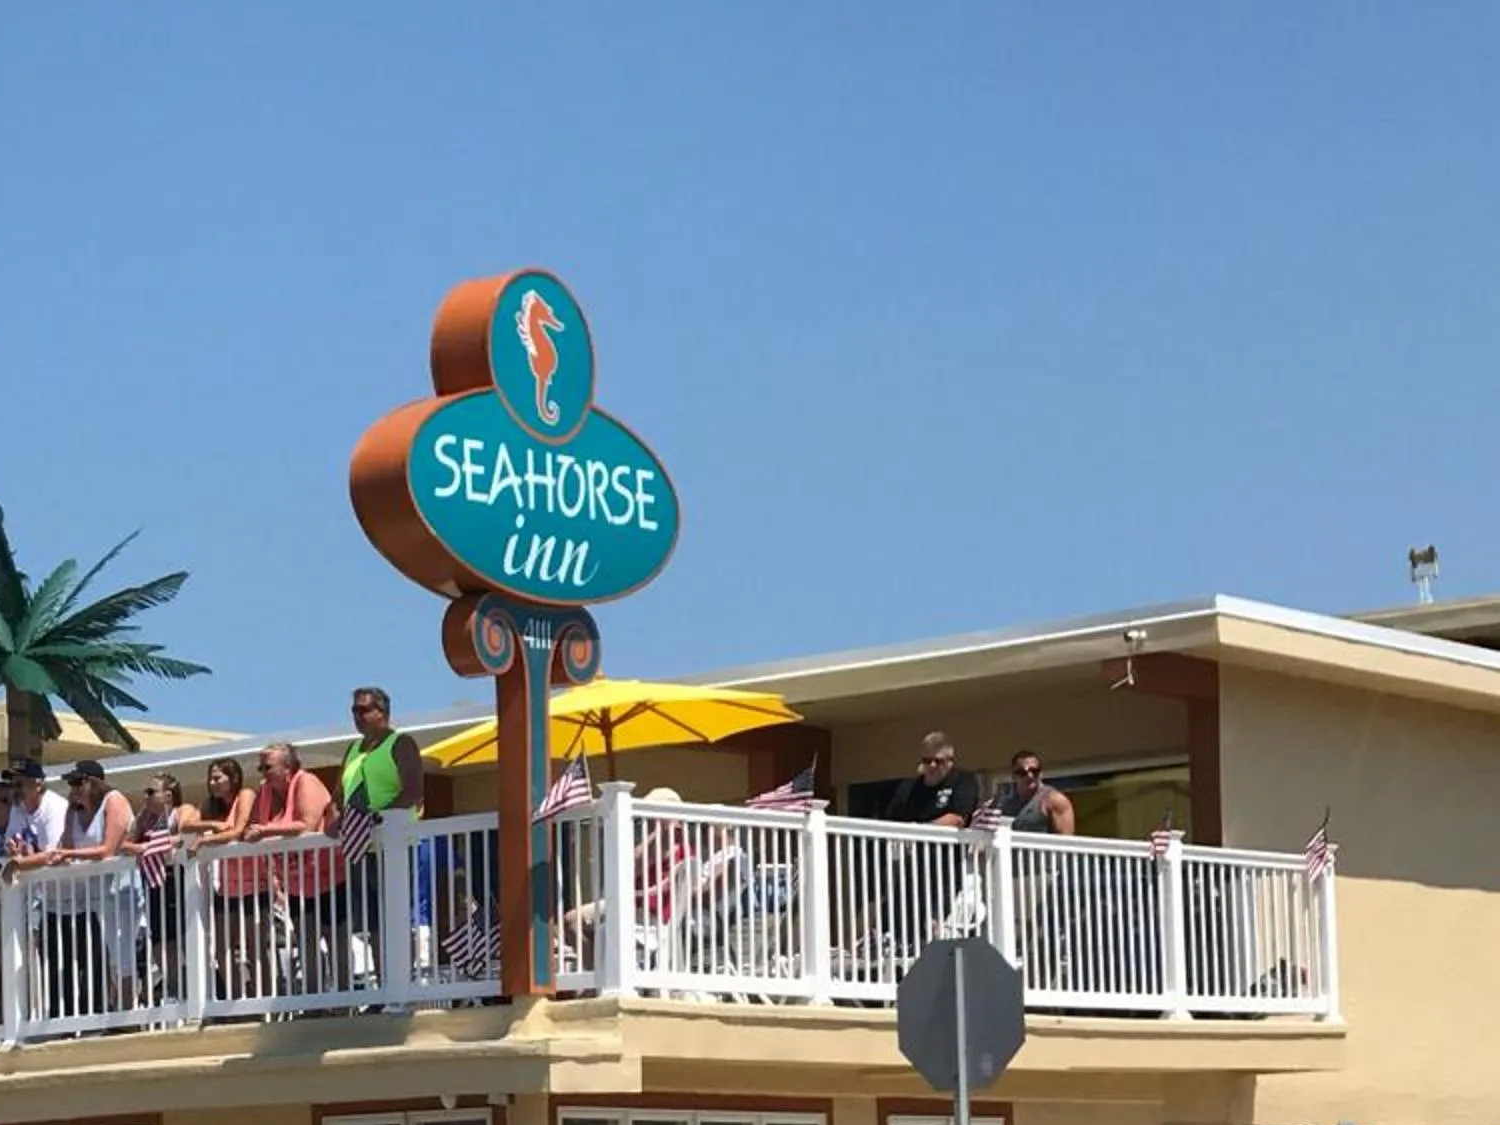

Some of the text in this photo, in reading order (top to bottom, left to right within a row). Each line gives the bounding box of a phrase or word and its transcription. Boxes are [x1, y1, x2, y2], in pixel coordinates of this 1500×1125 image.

[434, 433, 659, 532] SEAHORSE
[503, 513, 601, 587] inn
[523, 617, 552, 649] 4111
